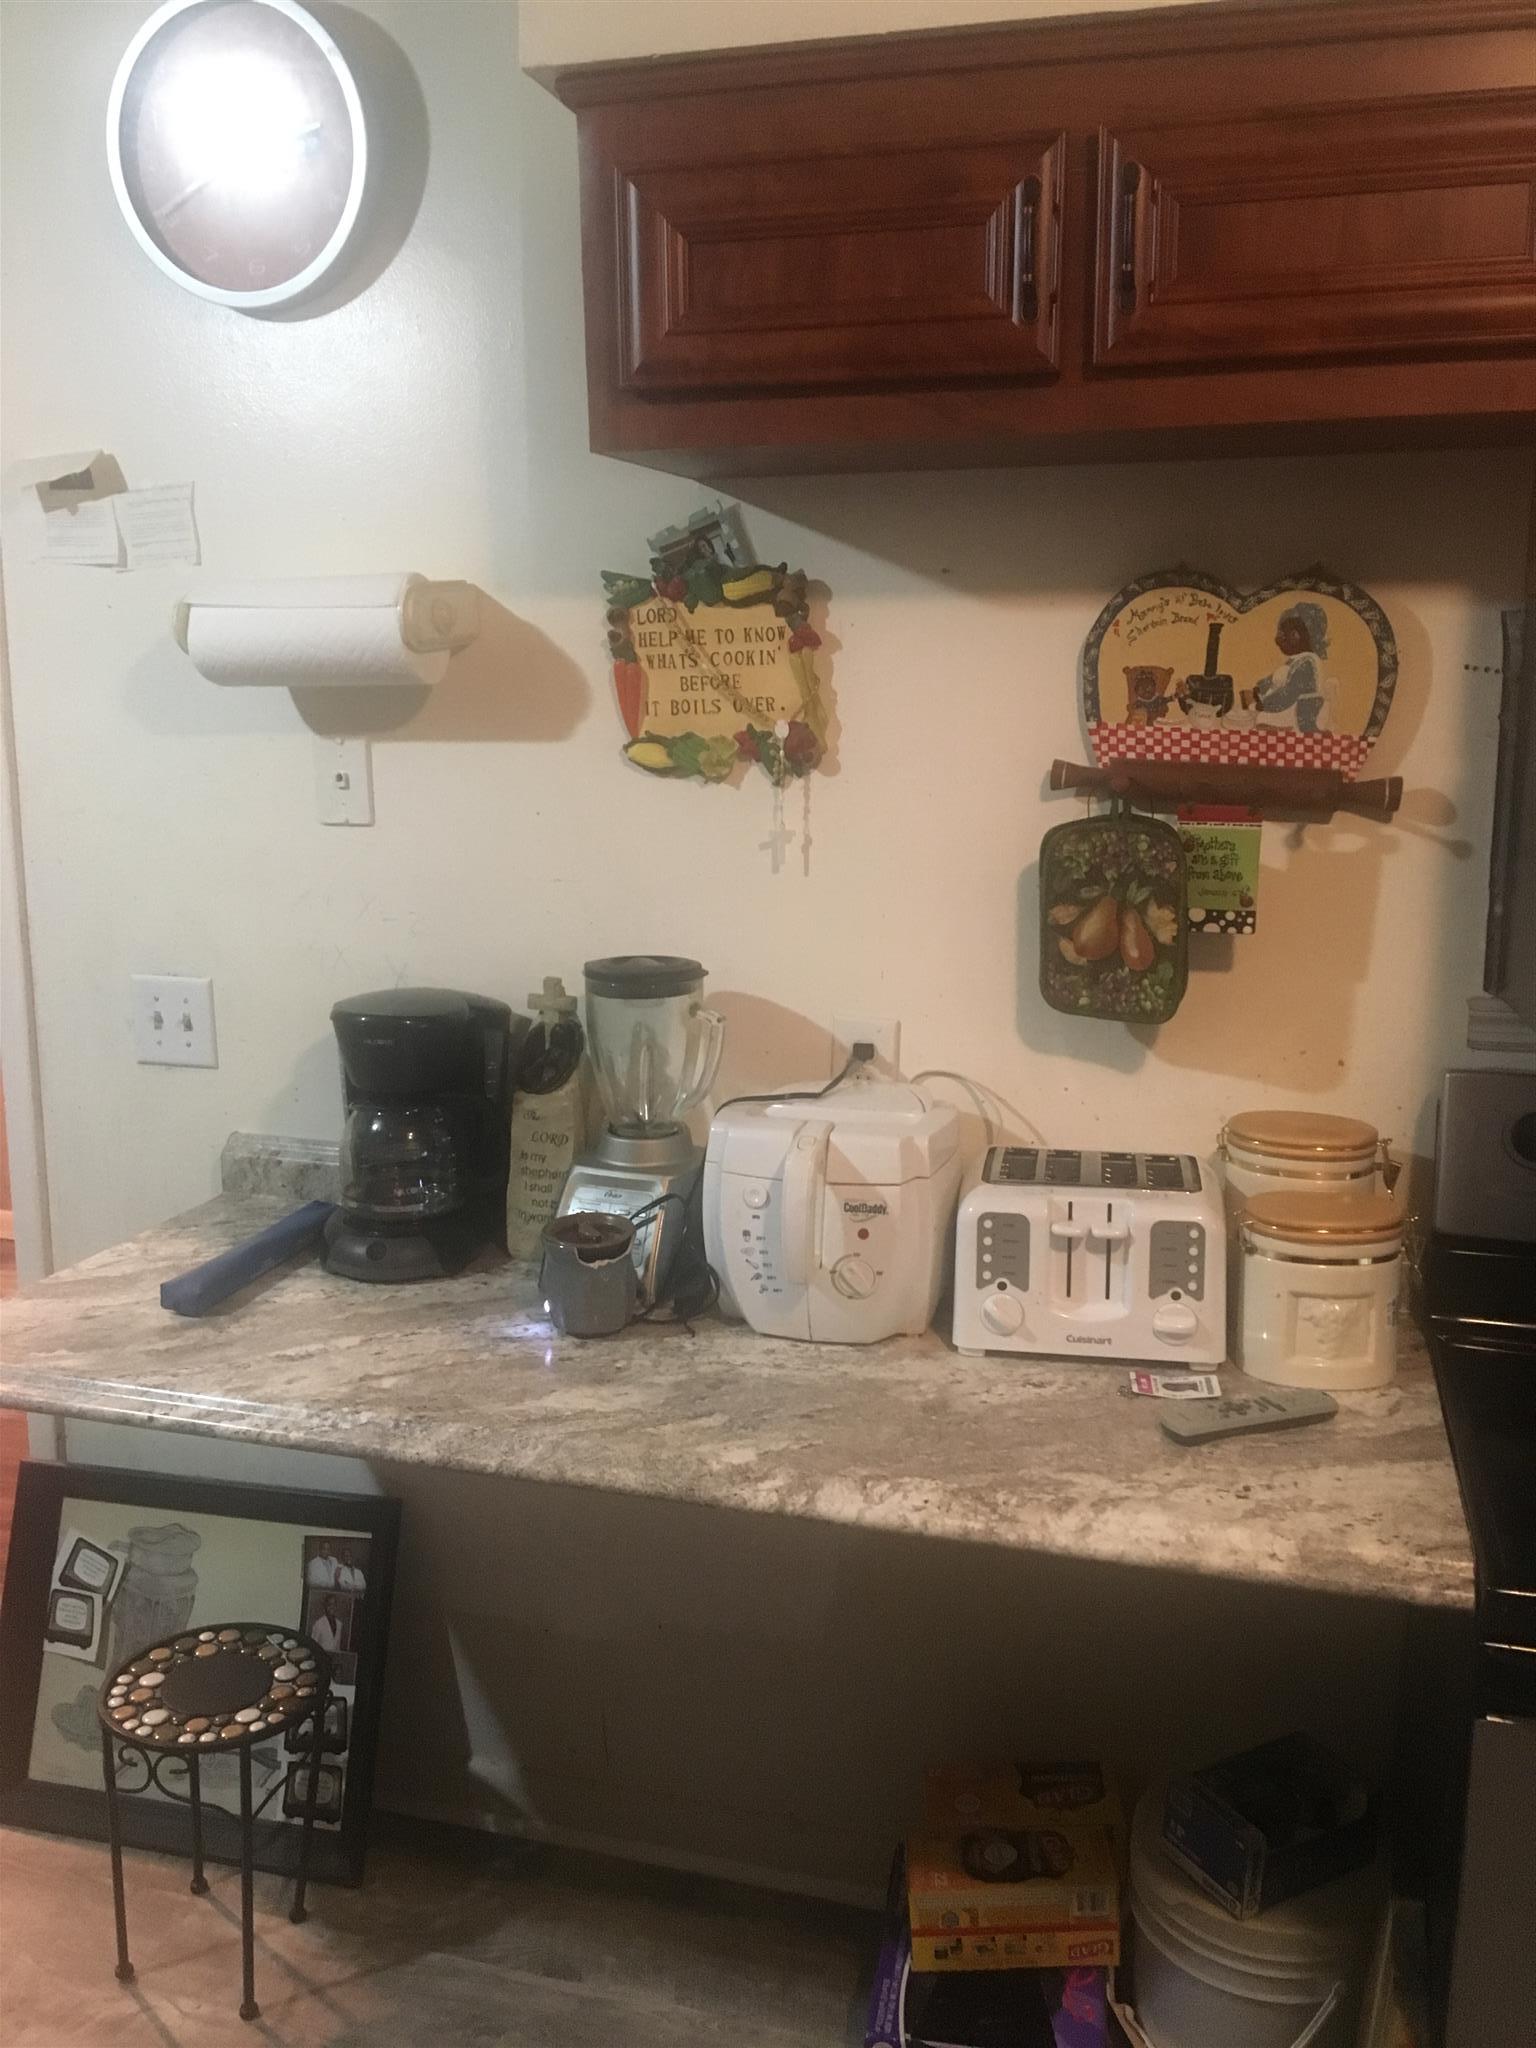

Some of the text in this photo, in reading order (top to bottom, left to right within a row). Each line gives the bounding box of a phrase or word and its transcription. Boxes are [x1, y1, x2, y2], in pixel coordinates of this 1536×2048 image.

[636, 607, 678, 626] LORD
[639, 625, 787, 648] HELP ME TO KNOW
[680, 675, 742, 692] BEFORE
[645, 696, 787, 717] IT BOILS OVER.
[1191, 854, 1208, 866] are
[1220, 853, 1240, 868] gift
[1212, 868, 1244, 882] above
[531, 1131, 569, 1147] LORD
[530, 1152, 547, 1164] my
[530, 1182, 553, 1194] shall
[532, 1199, 549, 1210] not
[1065, 1333, 1113, 1346] Cuisinart
